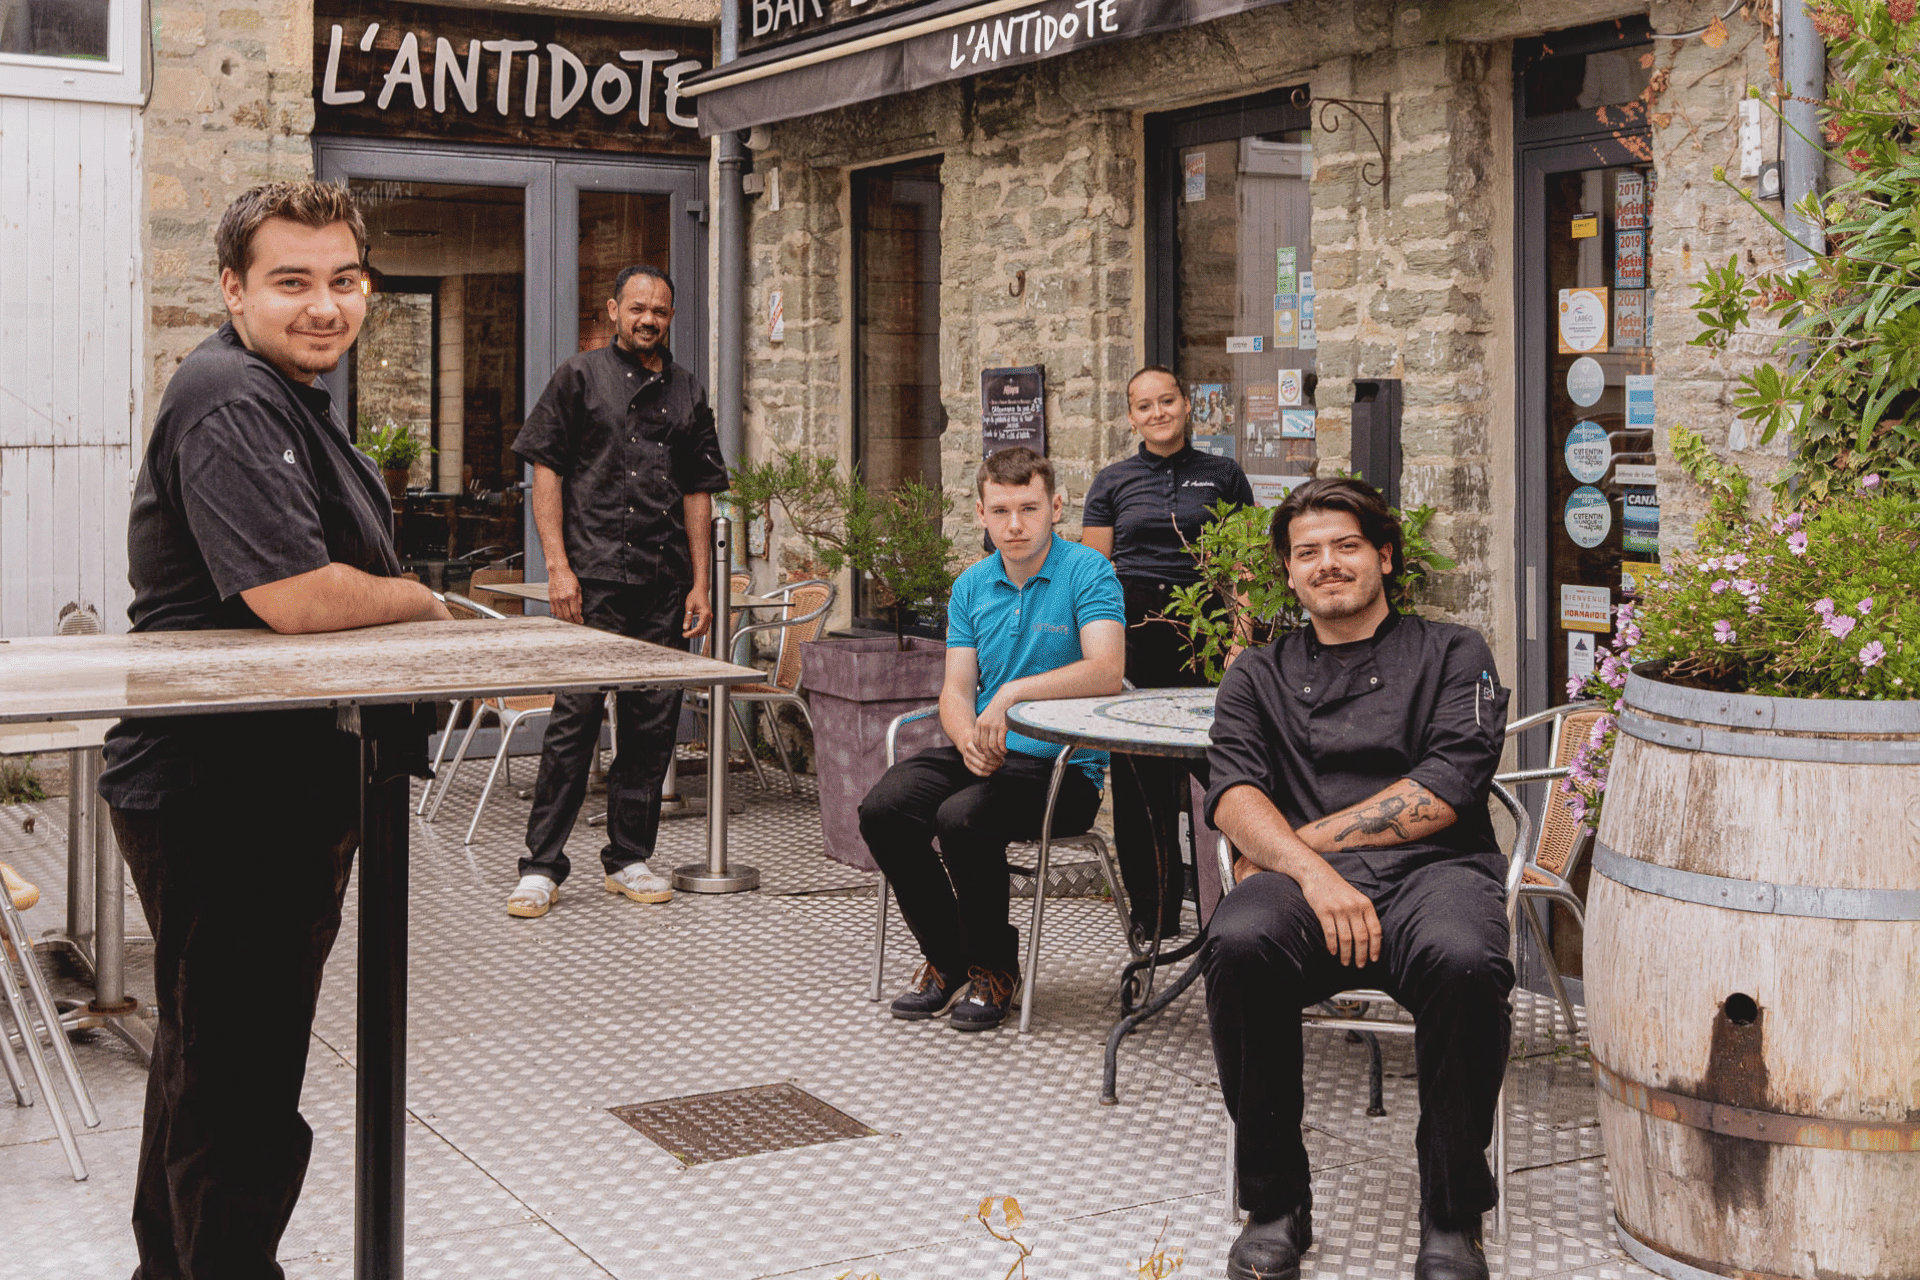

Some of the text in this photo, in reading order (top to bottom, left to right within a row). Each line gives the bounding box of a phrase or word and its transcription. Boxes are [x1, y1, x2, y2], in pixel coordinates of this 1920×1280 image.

[950, 0, 1119, 70] L'ANTIDOTE
[322, 22, 702, 129] L'ANTIDOTE
[1619, 182, 1642, 196] 2017
[1616, 203, 1645, 219] petit
[1620, 235, 1641, 248] 2019
[1617, 256, 1643, 270] petit
[1617, 293, 1642, 307] 2021
[1616, 316, 1642, 329] petit
[1573, 448, 1604, 456] COTENTIN
[1564, 593, 1607, 603] BIENVENUE
[1580, 602, 1590, 610] EN
[1564, 609, 1607, 619] NORMANDIE
